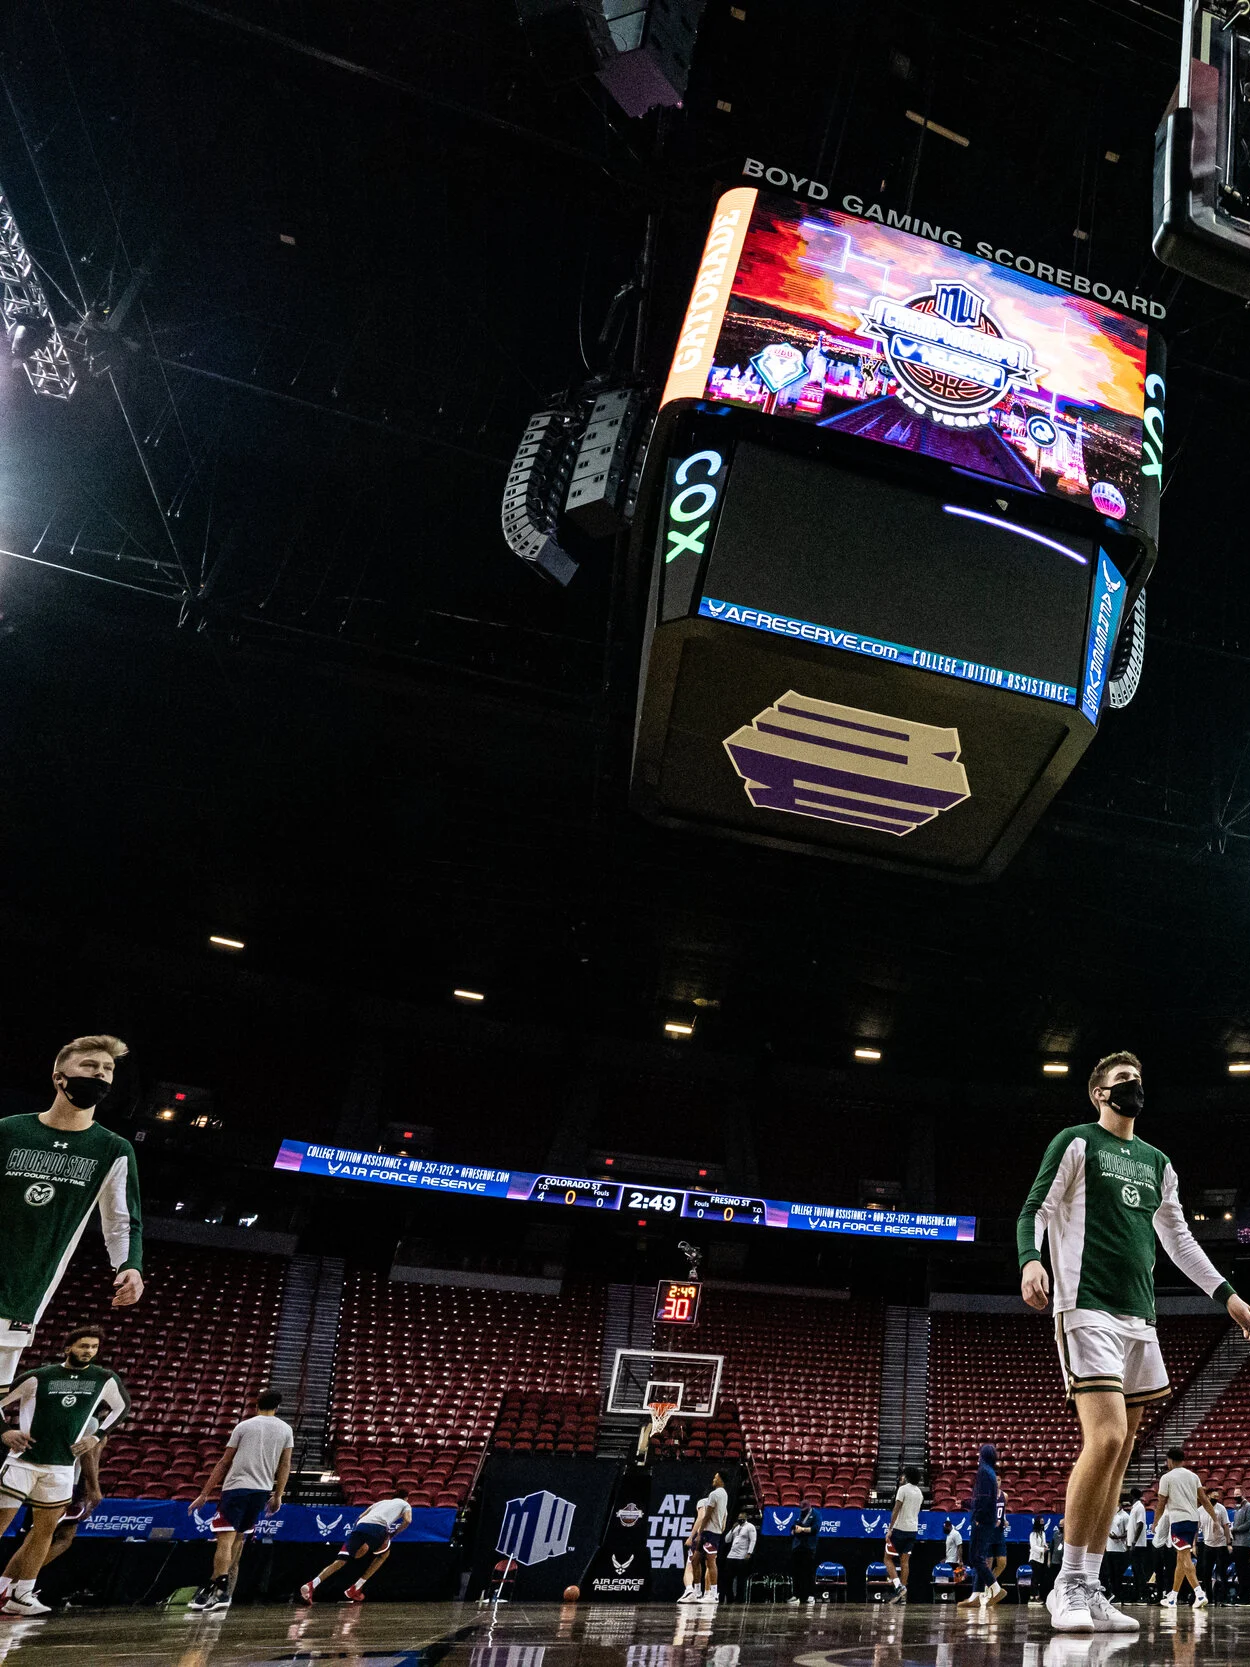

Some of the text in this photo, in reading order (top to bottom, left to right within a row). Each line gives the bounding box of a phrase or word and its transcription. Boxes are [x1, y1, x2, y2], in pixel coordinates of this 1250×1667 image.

[742, 157, 1167, 320] BOYD GAMING SCOREBOARD
[673, 209, 742, 374] GATORADE
[666, 450, 723, 563] COX
[725, 607, 1070, 702] AFRESERVE.com COLLEGE TUITION ASSISTANCE
[6, 1148, 98, 1181] COLORADO STATE
[307, 1145, 335, 1160] COLLEGE
[336, 1150, 362, 1164] TUITION
[362, 1153, 402, 1169] ASSISTANCE
[461, 1167, 510, 1183] AFRESERVE.COM
[341, 1166, 487, 1192] AIR FORCE RESERVE
[545, 1178, 602, 1190] COLORADO ST
[538, 1183, 549, 1191] T.O.
[593, 1189, 610, 1197] Fouls
[537, 1191, 545, 1201] 4
[564, 1190, 576, 1205] 0
[628, 1192, 676, 1212] 2:49
[710, 1196, 751, 1207] FRESNO ST
[596, 1198, 604, 1208] 0
[694, 1200, 710, 1208] Fouls
[696, 1209, 704, 1219] 0
[723, 1207, 734, 1222] 0
[752, 1206, 763, 1214] T.O.
[791, 1204, 813, 1217] COLLEGE
[814, 1207, 834, 1218] TUITION
[835, 1209, 867, 1221] ASSISTANCE
[752, 1215, 760, 1224] 4
[819, 1220, 939, 1236] AIR FORCE RESERVE
[669, 1285, 697, 1298] 2:49
[663, 1298, 690, 1319] 30
[658, 1494, 691, 1515] AT
[83, 1515, 153, 1524] AIR FORCE
[85, 1523, 147, 1531] RESERVE
[648, 1516, 695, 1537] THE
[593, 1578, 610, 1586] AIR
[822, 1591, 829, 1599] G
[874, 1592, 882, 1600] G
